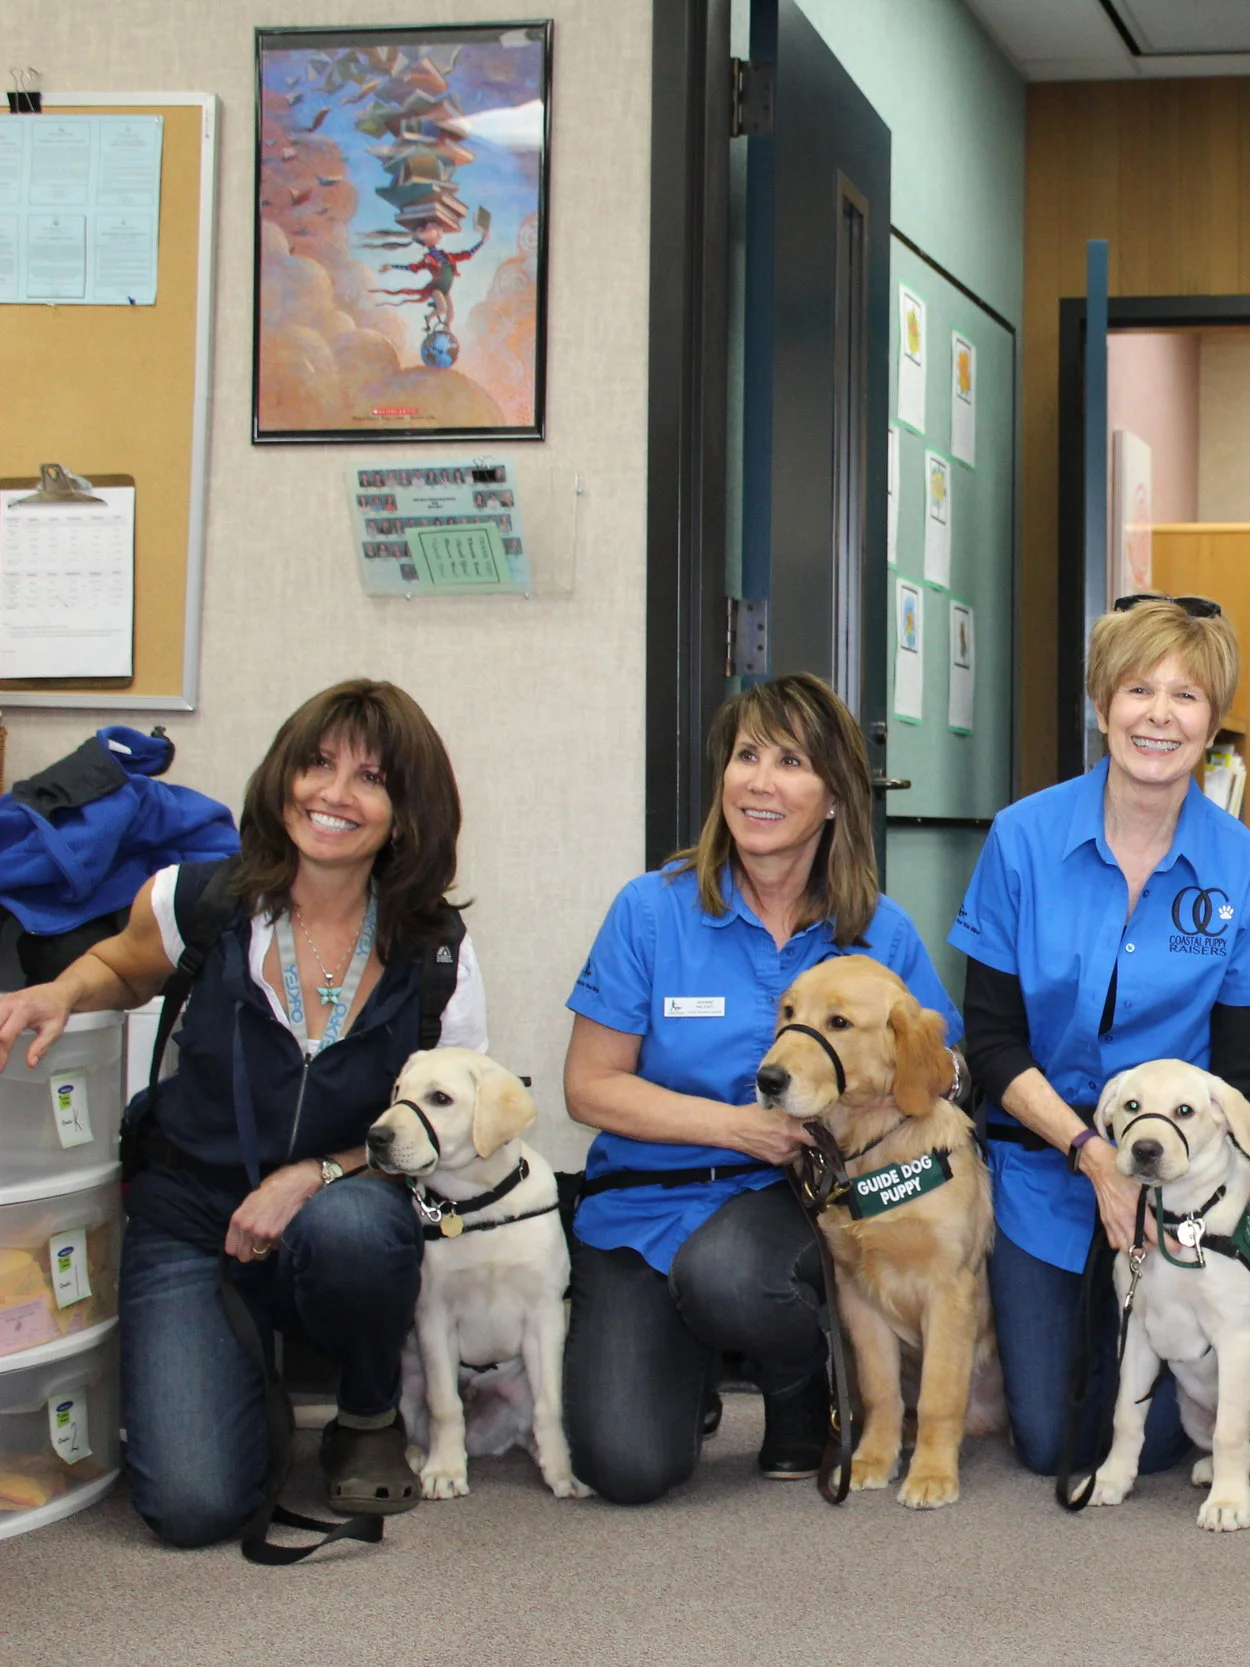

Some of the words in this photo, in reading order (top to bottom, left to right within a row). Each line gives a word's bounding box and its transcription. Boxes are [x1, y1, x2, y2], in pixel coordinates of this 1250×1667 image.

[1169, 935, 1203, 947] COASTAL
[1205, 937, 1228, 948] PUPPY
[1169, 944, 1227, 957] RAISERS
[857, 1168, 901, 1196] GUIDE
[900, 1154, 933, 1179] DOG
[879, 1176, 922, 1206] PUPPY
